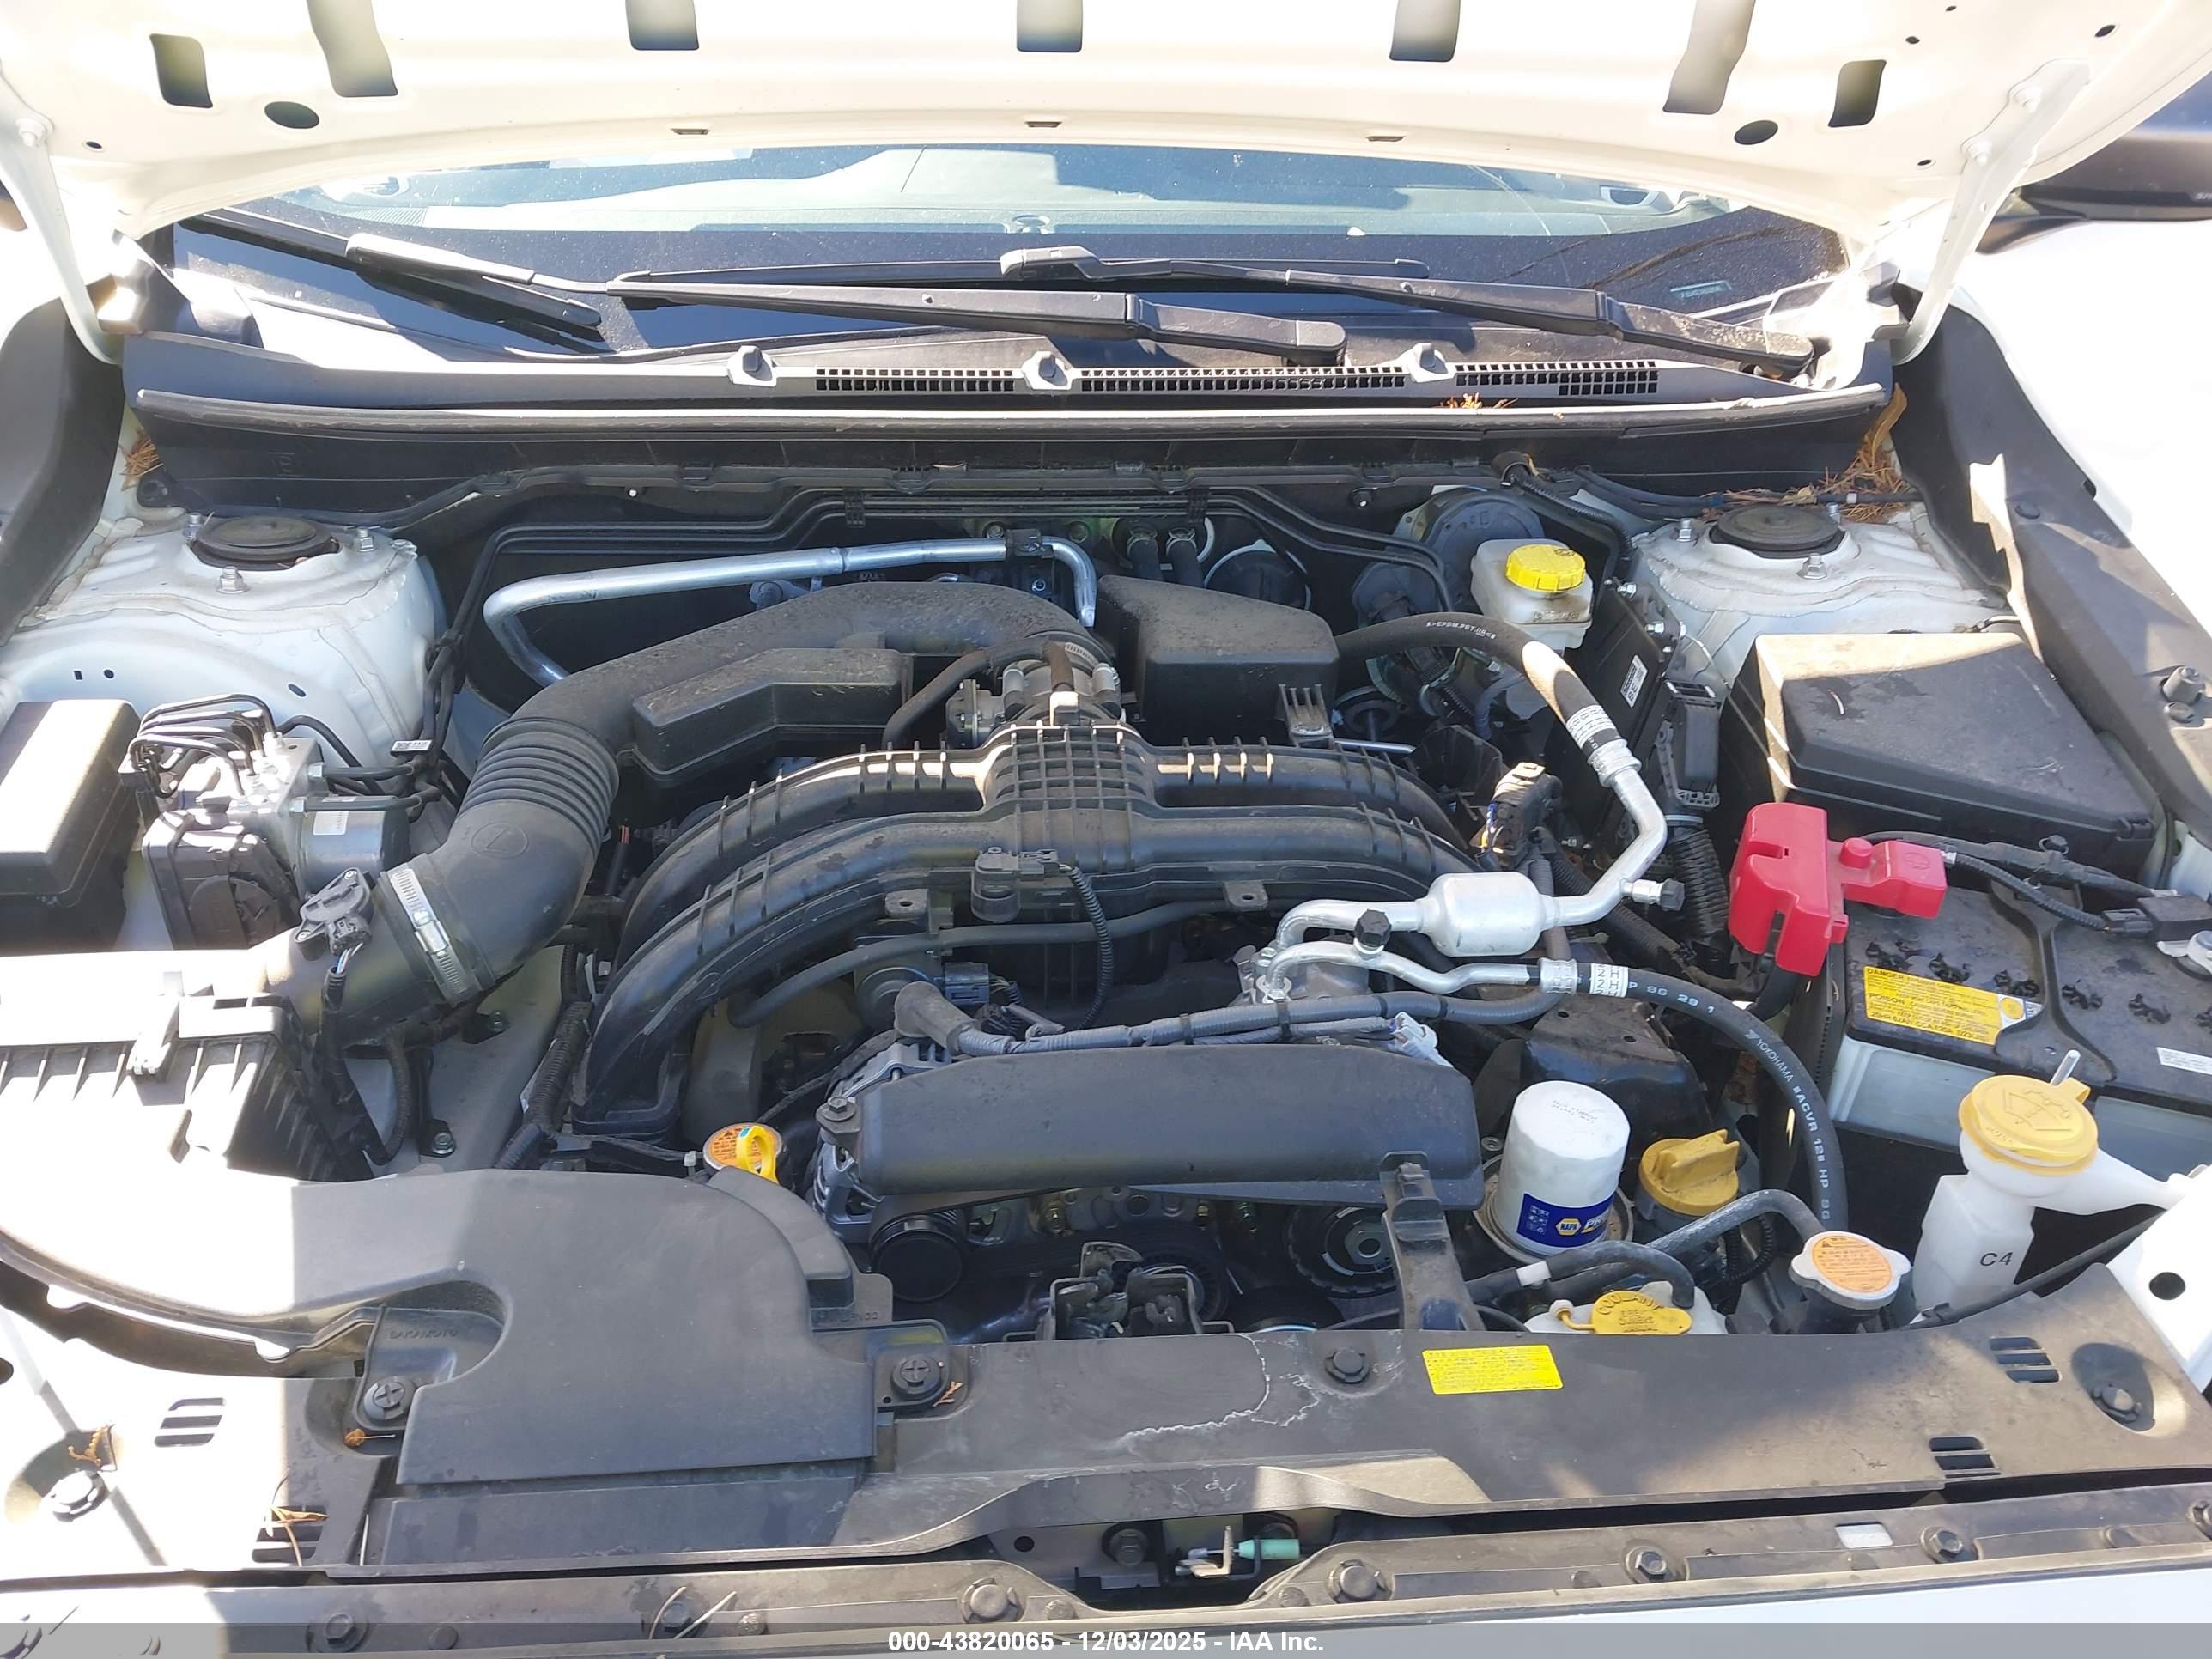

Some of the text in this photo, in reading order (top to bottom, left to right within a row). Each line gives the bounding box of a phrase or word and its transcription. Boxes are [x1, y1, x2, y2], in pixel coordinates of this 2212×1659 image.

[1757, 1037, 1794, 1083] YOKOHAMA
[1979, 1251, 2014, 1267] C4
[1596, 1292, 1663, 1316] COOLANT
